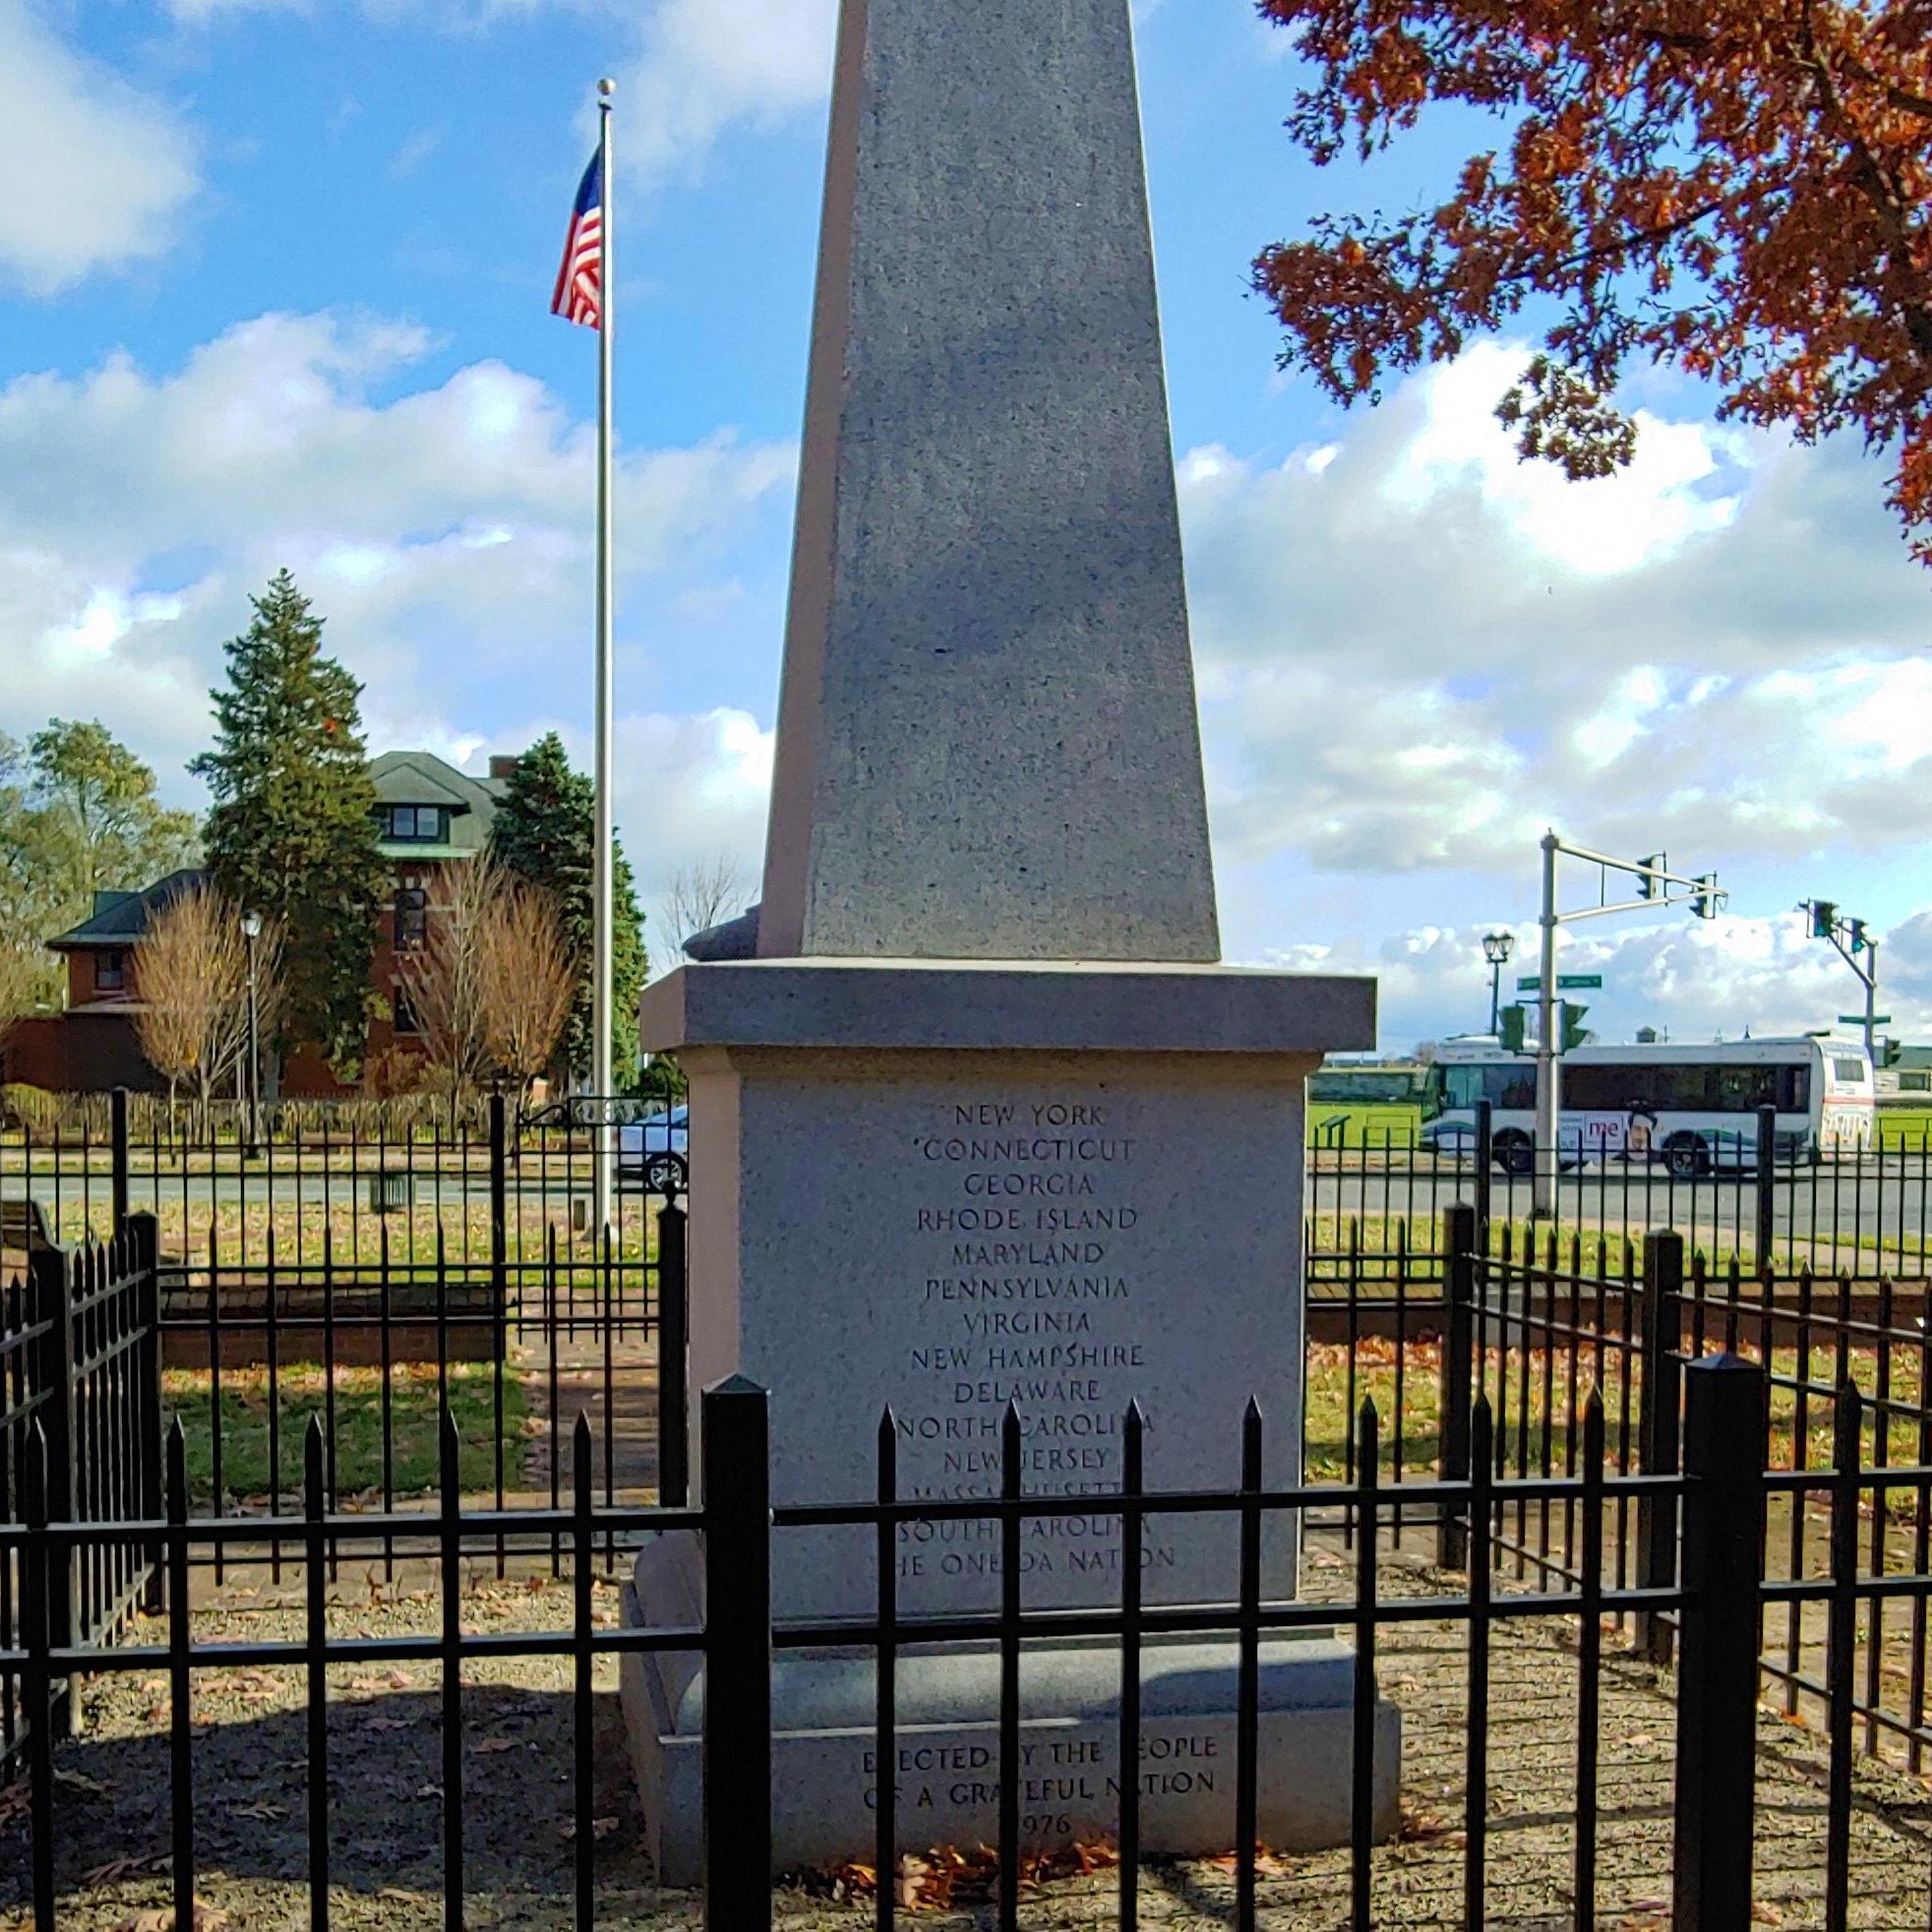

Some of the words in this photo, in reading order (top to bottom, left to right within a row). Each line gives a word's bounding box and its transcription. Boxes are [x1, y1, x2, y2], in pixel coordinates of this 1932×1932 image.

[955, 1104, 1015, 1127] NEW
[1032, 1103, 1104, 1126] YORK
[923, 1137, 1136, 1162] CONNECTICUT
[963, 1172, 1095, 1196] GEORGIA
[918, 1207, 1022, 1232] RHODE
[1036, 1207, 1138, 1231] ISLAND
[952, 1242, 1105, 1267] MARYLAND
[926, 1277, 1129, 1300] PENNSYLVANIA
[963, 1311, 1091, 1336] VIRGINIA
[911, 1347, 973, 1370] NEW
[988, 1344, 1144, 1368] HAMPSHIRE
[954, 1379, 1103, 1403] DELAWARE
[896, 1416, 998, 1439] NORTH
[1017, 1414, 1155, 1436] CAROLIA
[943, 1450, 1002, 1474] NEW
[1020, 1447, 1109, 1471] JERSEY
[897, 1518, 994, 1542] SOUTH
[940, 1551, 1054, 1575] ONEDA
[1068, 1547, 1177, 1572] NATON
[862, 1746, 991, 1774] EECTED
[1050, 1740, 1103, 1764] THE
[1131, 1735, 1219, 1761] EOPLE
[916, 1785, 934, 1808] A
[948, 1777, 1094, 1805] GRAEFUL
[1105, 1771, 1214, 1797] NTION
[1015, 1814, 1071, 1836] 976
